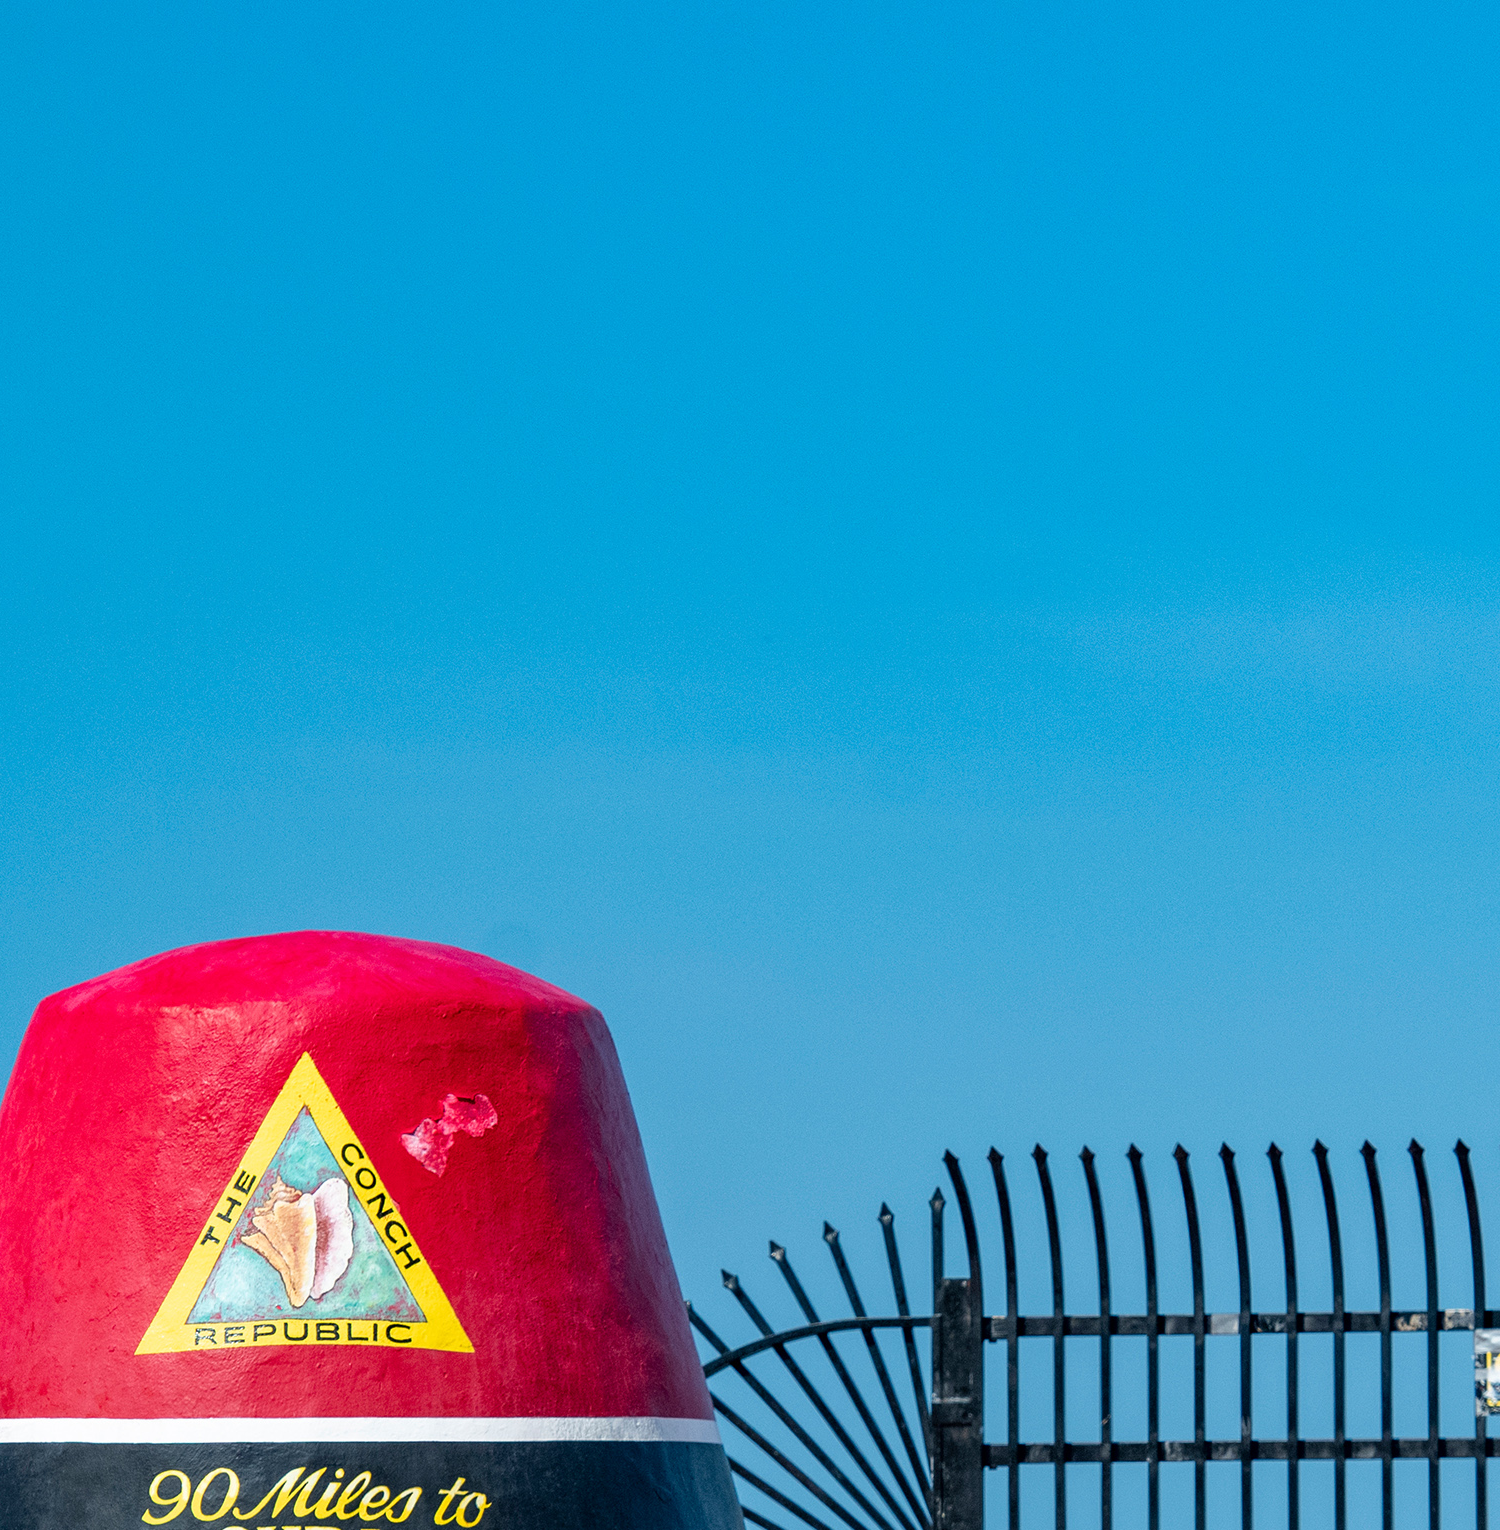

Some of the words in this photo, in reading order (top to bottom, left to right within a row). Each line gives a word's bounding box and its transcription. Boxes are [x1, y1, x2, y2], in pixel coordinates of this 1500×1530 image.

[200, 1169, 257, 1246] THE
[340, 1142, 421, 1270] CONCH
[193, 1322, 413, 1346] REPUBLIC
[141, 1467, 241, 1526] 90
[233, 1466, 423, 1524] Miles
[433, 1476, 493, 1528] to
